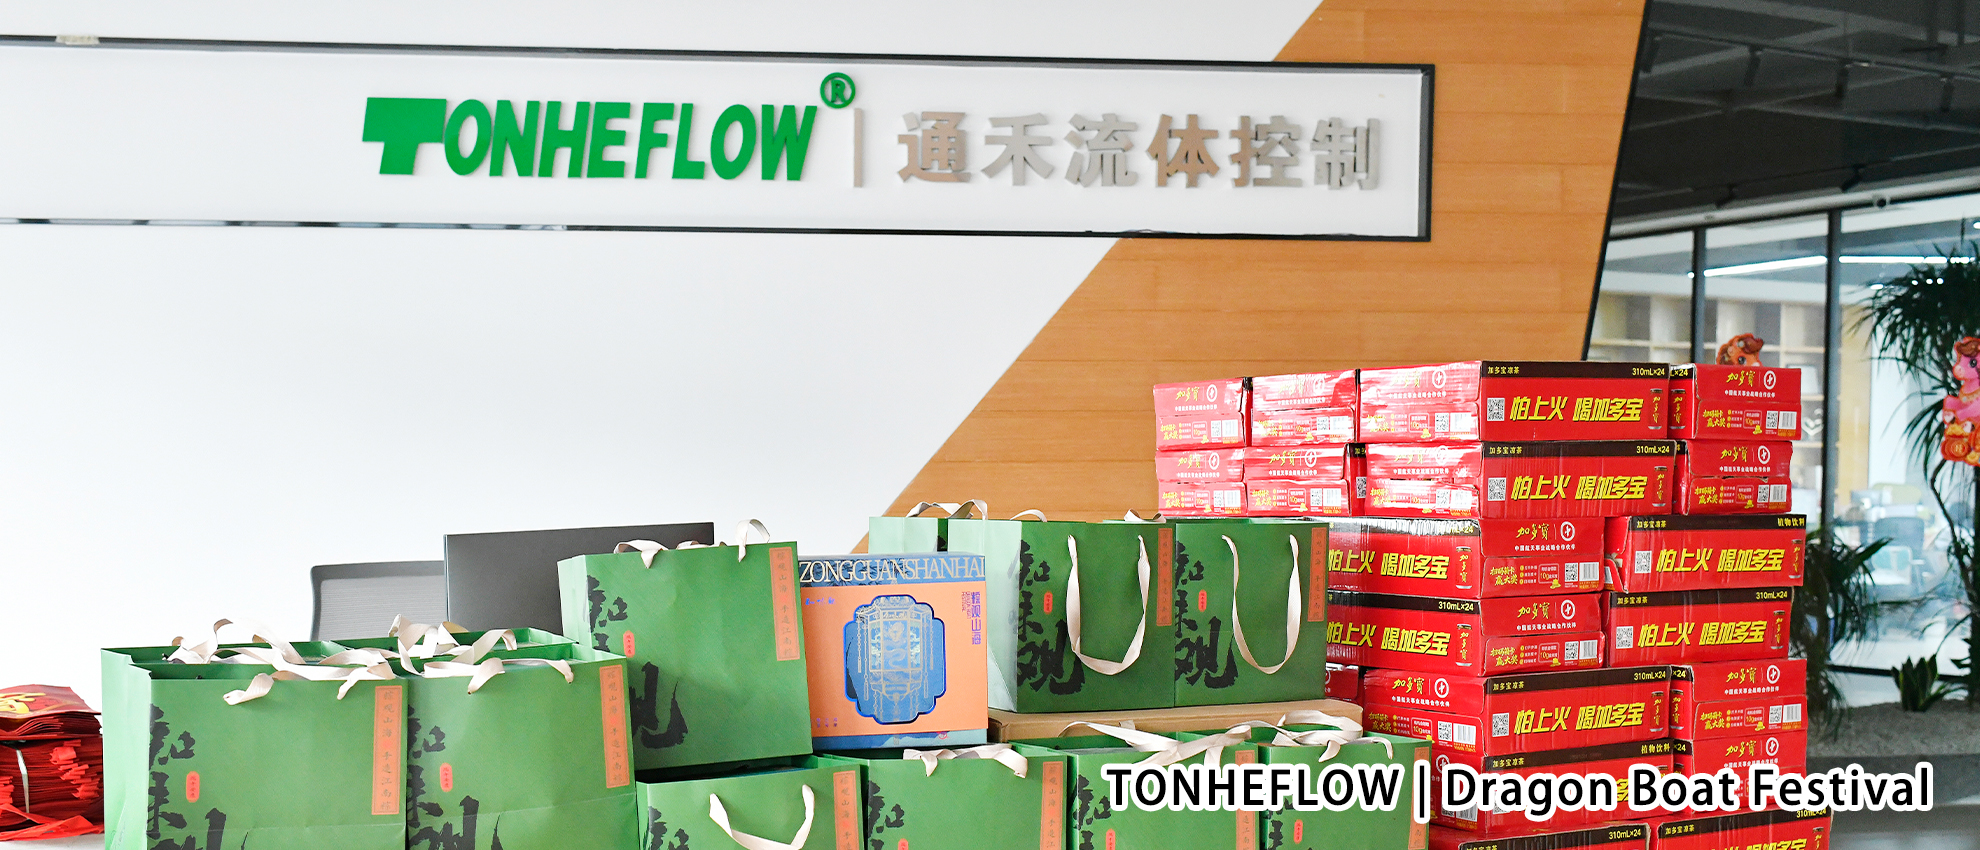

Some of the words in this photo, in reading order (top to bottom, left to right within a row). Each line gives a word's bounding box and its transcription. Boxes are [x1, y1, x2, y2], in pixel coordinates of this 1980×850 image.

[363, 97, 818, 181] TONHEFLOW
[898, 111, 1382, 190] 通禾流体控制
[1487, 366, 1520, 375] 加多宝凉茶
[1509, 396, 1568, 421] 怕上火
[1572, 397, 1644, 422] 喝加多宝
[1489, 446, 1522, 455] 加多宝凉茶
[1510, 476, 1570, 500] 怕上火
[1574, 476, 1648, 500] 喝加多宝
[1637, 520, 1666, 528] 加多宝凉茶
[1778, 518, 1805, 528] 植物饮料
[799, 556, 985, 583] ZONGGUANSHANHAI
[1328, 549, 1376, 574] 怕上火
[1380, 553, 1450, 579] 喝加多宝
[1656, 549, 1714, 573] 怕上火
[1716, 549, 1786, 572] 喝加多宝
[1617, 596, 1648, 605] 加多宝凉茶
[1326, 622, 1376, 648] 怕上火
[1380, 627, 1450, 656] 喝加多宝
[1637, 622, 1695, 648] 怕上火
[1698, 621, 1768, 646] 喝加多宝
[1492, 680, 1524, 690] 加多宝凉茶
[1513, 707, 1572, 735] 怕上火
[1576, 701, 1645, 731] 喝加多宝
[1641, 743, 1670, 754] 植物饮料
[1666, 825, 1694, 836] 加多宝凉茶
